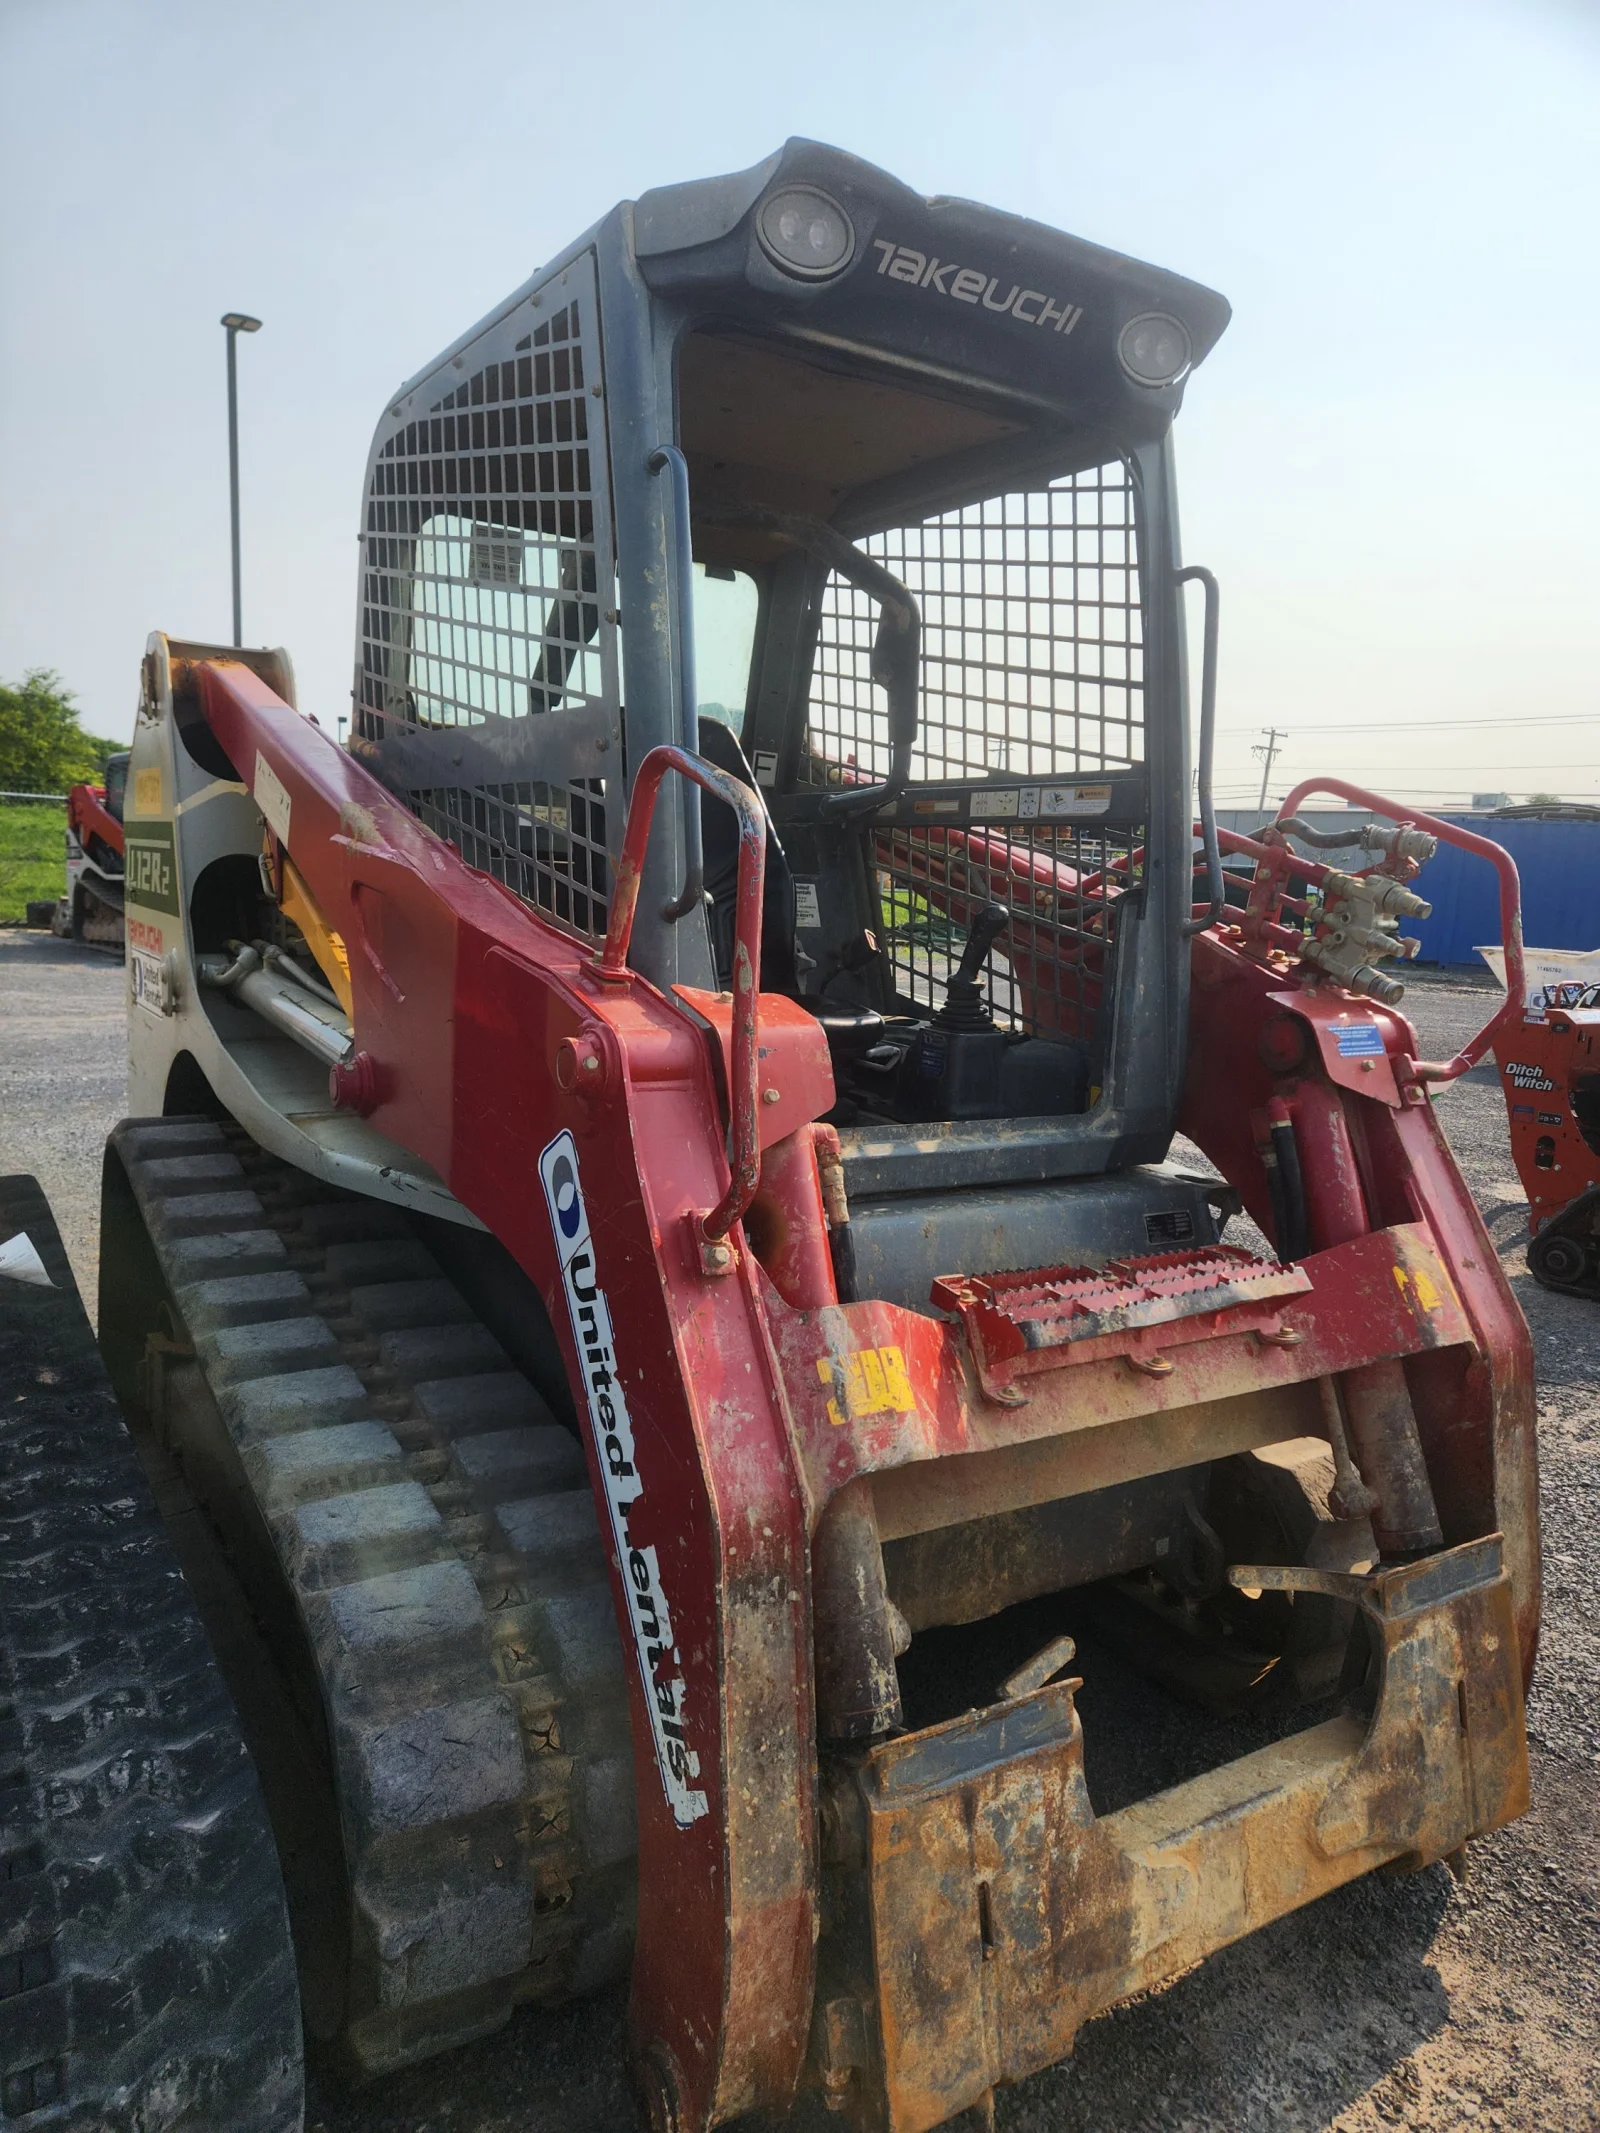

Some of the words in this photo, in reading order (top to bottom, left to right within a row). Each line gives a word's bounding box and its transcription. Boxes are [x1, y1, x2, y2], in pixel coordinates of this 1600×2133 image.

[480, 561, 515, 573] WARNIG
[1505, 1063, 1543, 1077] Ditch
[1514, 1076, 1553, 1091] Witch
[570, 1253, 634, 1477] United
[618, 1501, 692, 1783] entals
